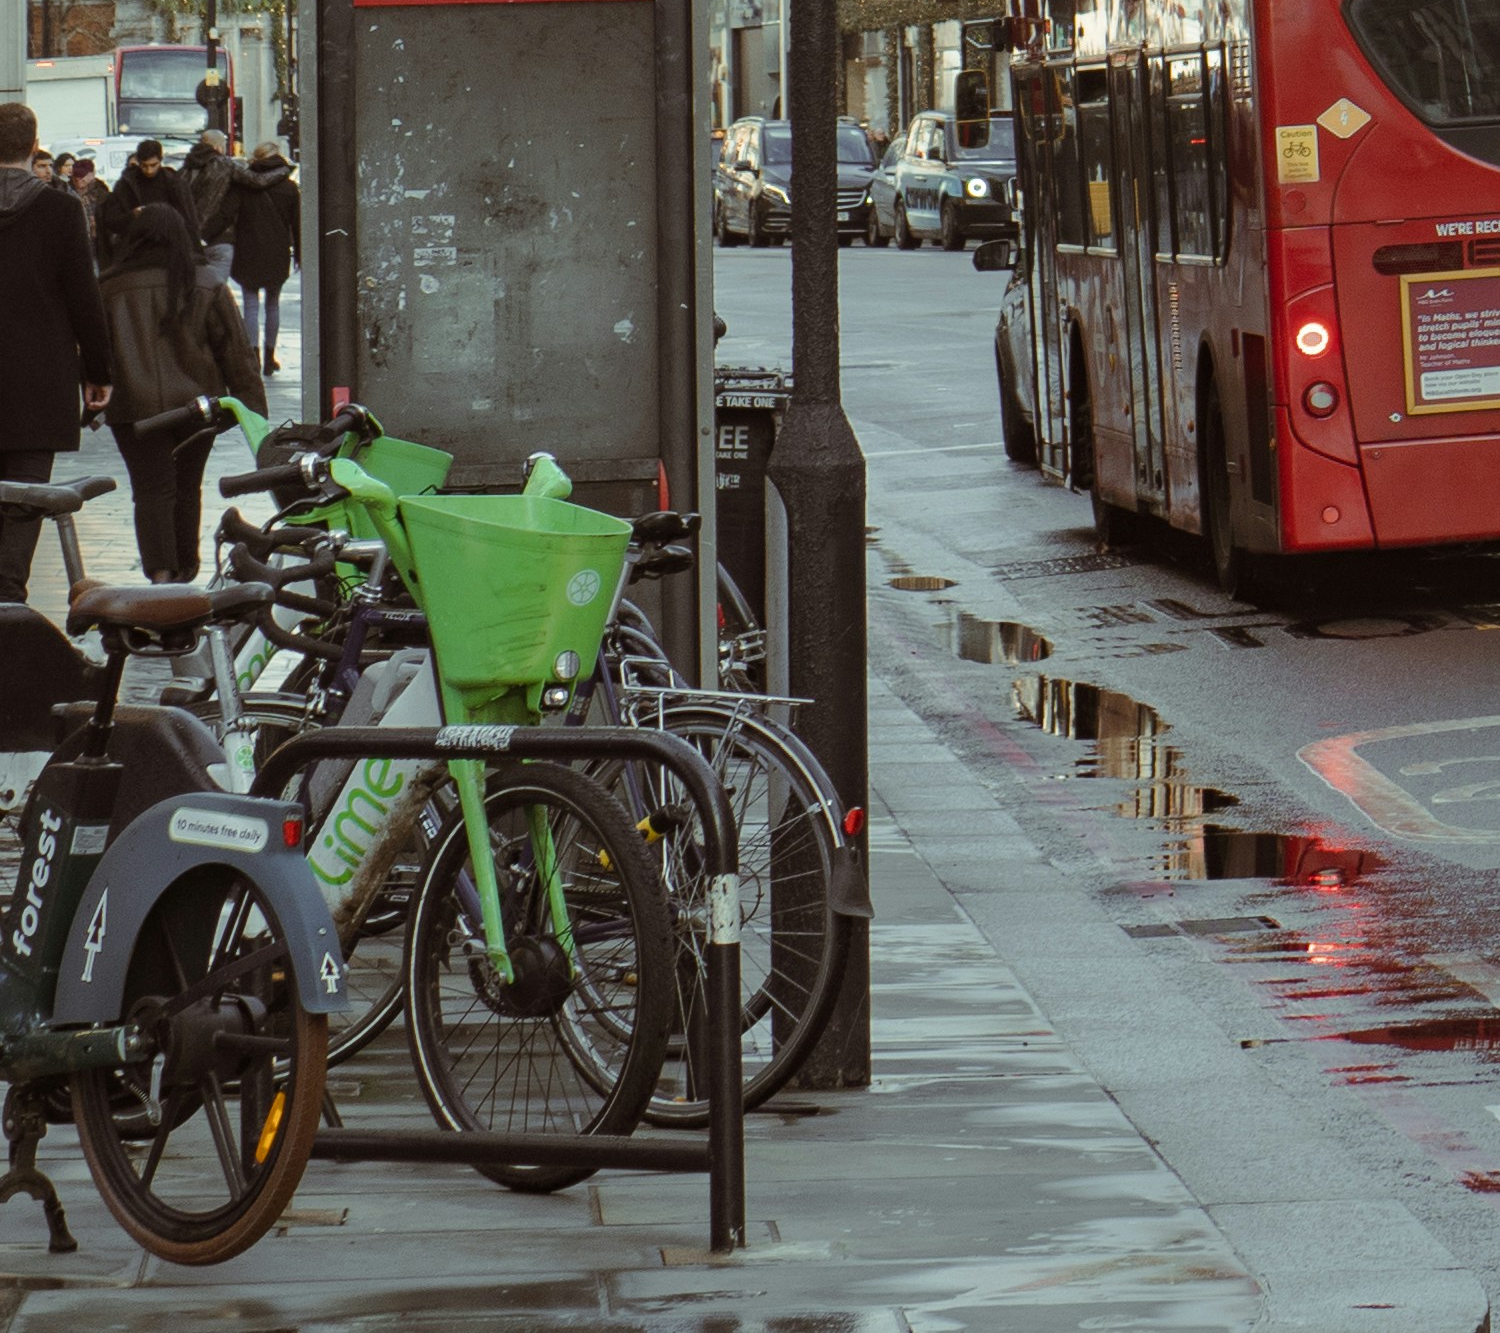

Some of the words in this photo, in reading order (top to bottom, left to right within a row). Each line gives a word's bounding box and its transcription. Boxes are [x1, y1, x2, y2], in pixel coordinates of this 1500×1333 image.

[1280, 131, 1312, 139] Caution
[1436, 221, 1473, 237] WE'RE
[1418, 322, 1450, 332] stretch
[1418, 333, 1428, 341] to
[1419, 342, 1436, 351] and
[1438, 339, 1469, 351] logical
[726, 396, 751, 407] TAKE
[754, 397, 776, 408] ONE
[719, 426, 749, 449] EE
[308, 757, 404, 886] Lime
[177, 819, 187, 830] 10
[187, 821, 219, 835] minutes
[220, 825, 239, 837] free
[239, 828, 262, 844] daily
[12, 808, 62, 958] forest
